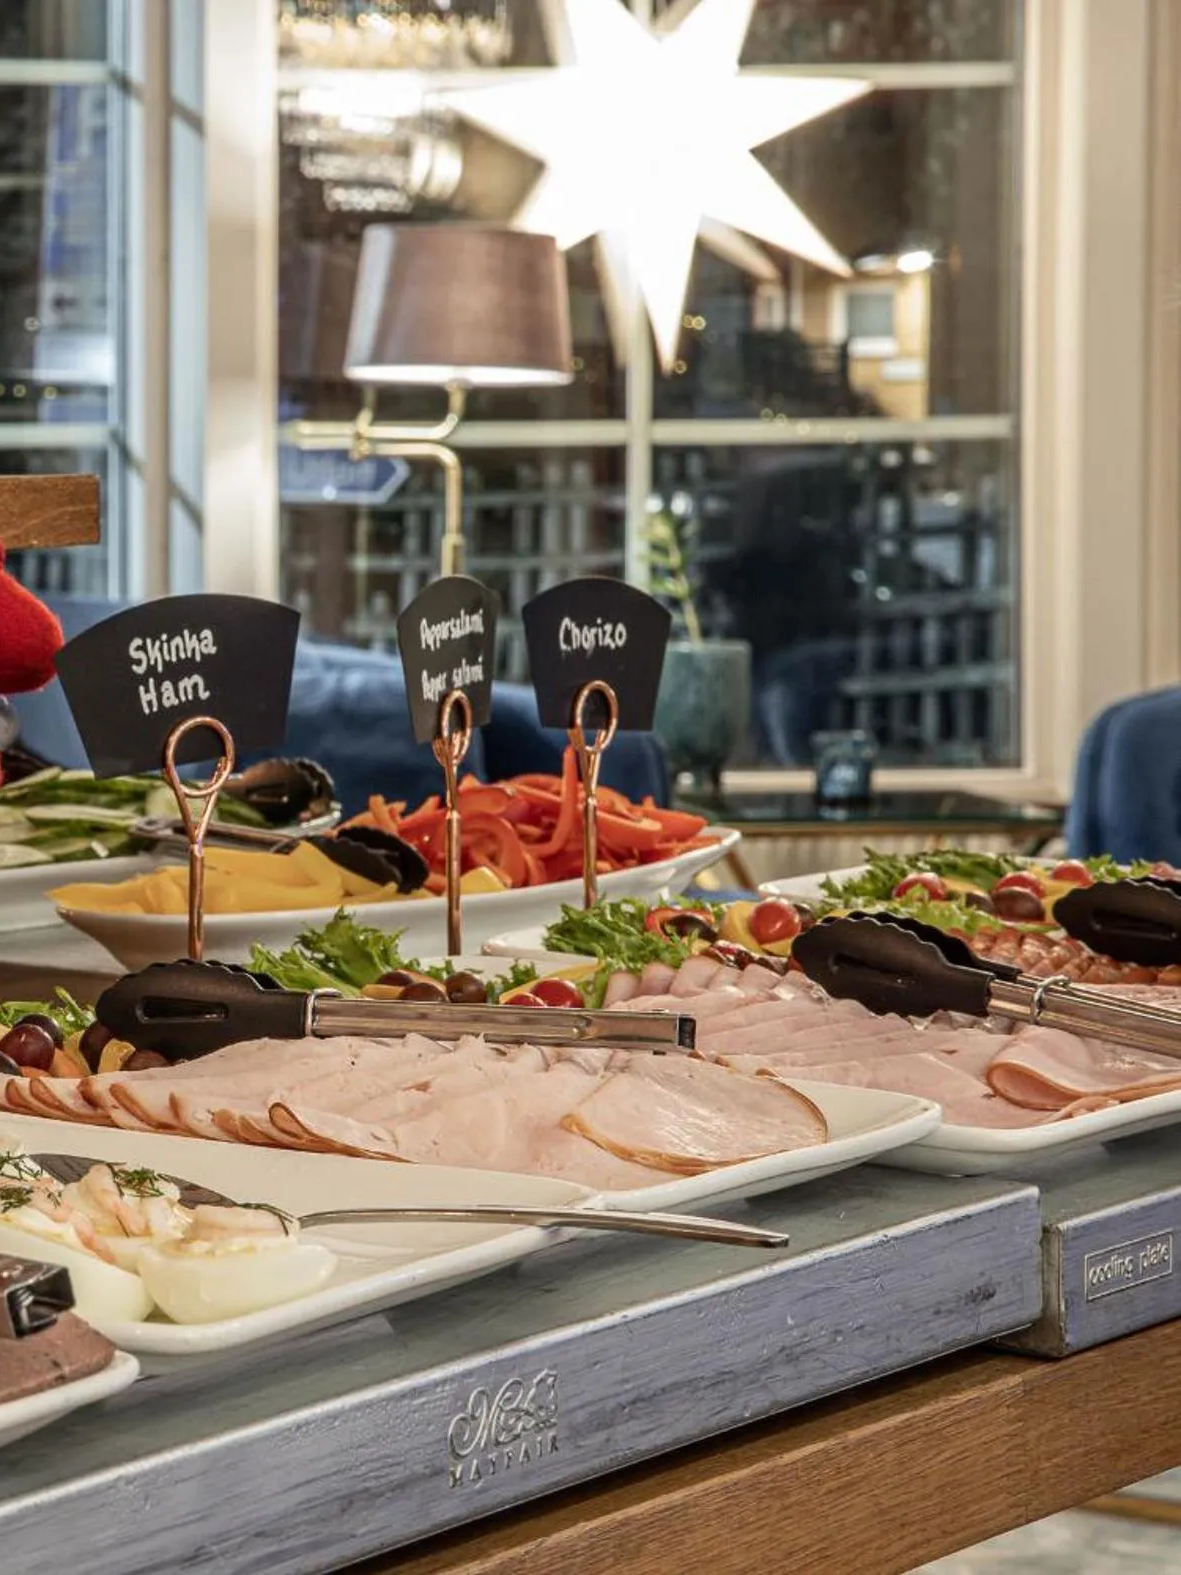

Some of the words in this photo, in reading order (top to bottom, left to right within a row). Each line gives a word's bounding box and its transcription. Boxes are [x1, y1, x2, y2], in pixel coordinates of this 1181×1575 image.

[128, 629, 217, 674] Skinka
[559, 617, 627, 651] Chorizo
[139, 674, 211, 715] Ham
[448, 1432, 560, 1489] MAYFAIR
